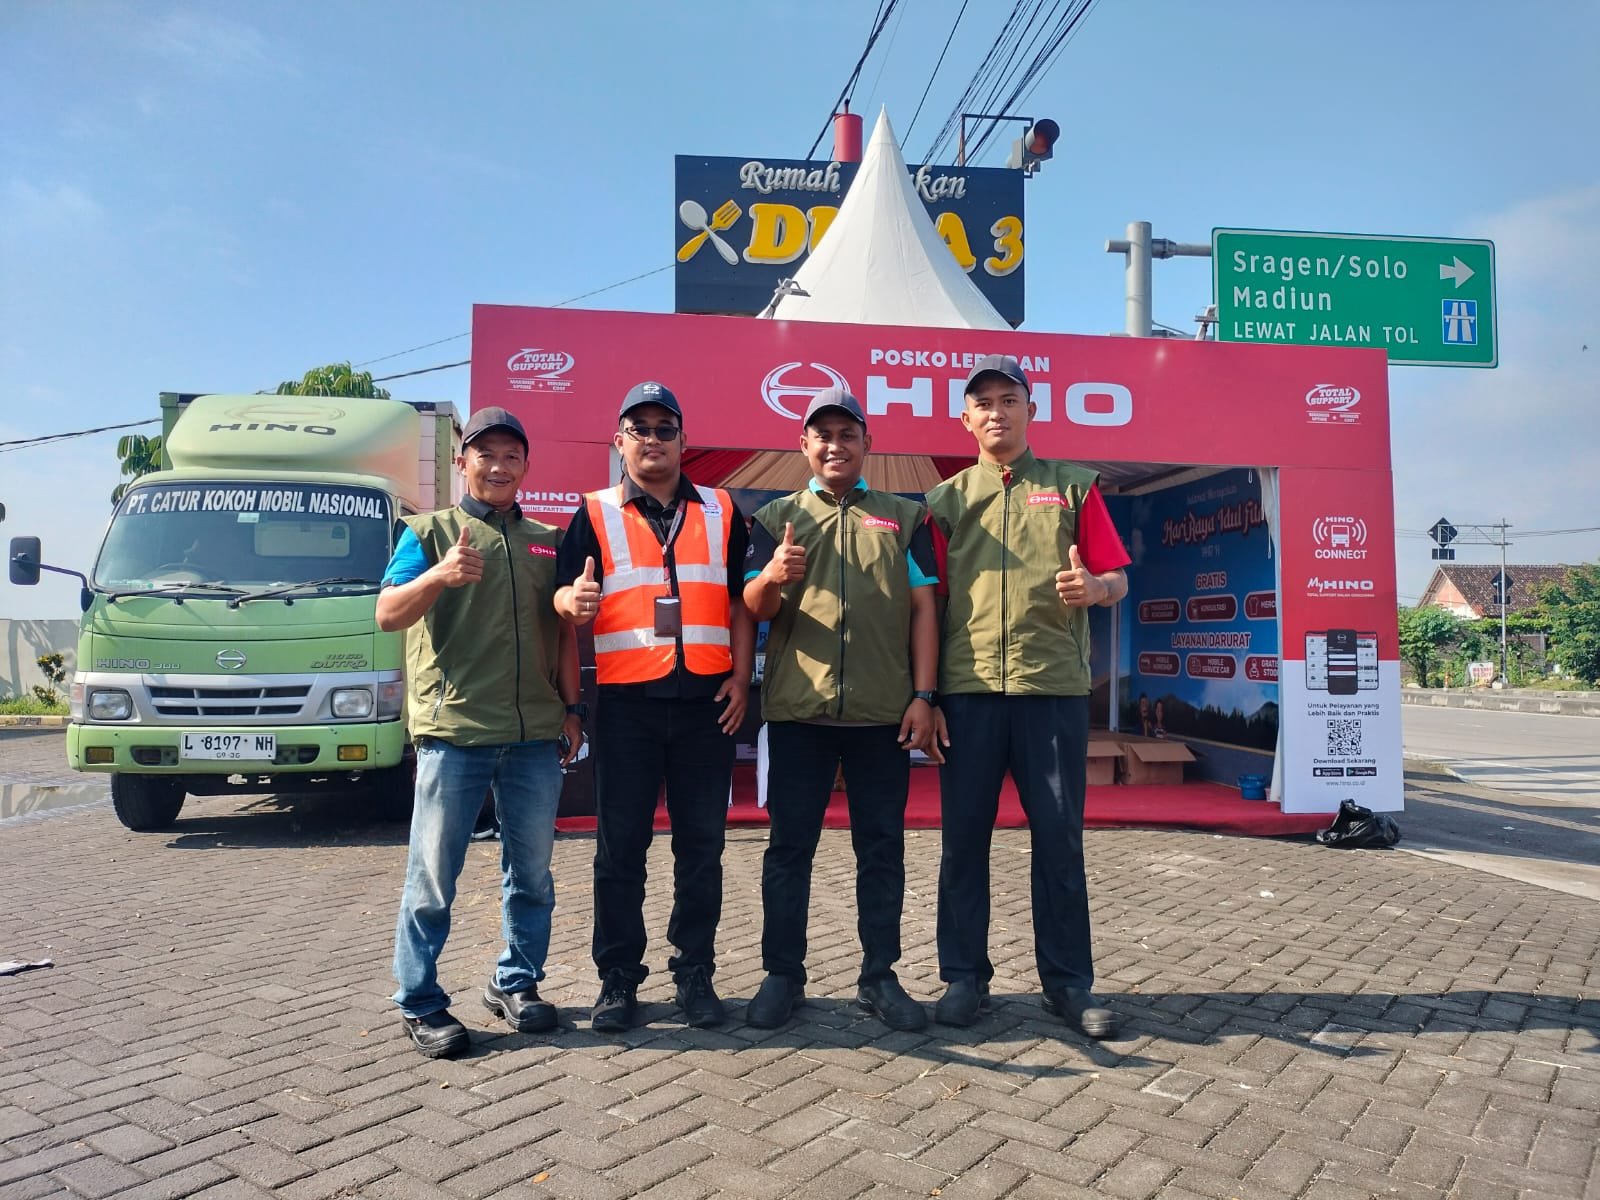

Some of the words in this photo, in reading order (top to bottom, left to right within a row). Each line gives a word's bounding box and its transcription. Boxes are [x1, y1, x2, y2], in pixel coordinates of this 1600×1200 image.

[740, 161, 840, 194] Rumah
[910, 166, 966, 203] kan
[984, 216, 1024, 277] 3
[1233, 250, 1408, 281] Sragen/Solo
[1233, 286, 1332, 311] Madiun
[1234, 321, 1296, 340] LEWAT
[1309, 323, 1371, 342] JALAN
[1382, 326, 1419, 344] TOL
[524, 353, 563, 363] TOTAL
[871, 349, 947, 368] POSKO
[951, 352, 1050, 373] LEAN
[513, 362, 563, 371] SUPPORT
[1319, 388, 1352, 397] TOTAL
[1310, 396, 1352, 405] SUPPORT
[209, 423, 337, 436] HINO
[127, 493, 147, 515] PT.
[150, 490, 200, 512] CATUR
[202, 489, 258, 511] KOKOH
[258, 490, 305, 513] MOBIL
[308, 492, 384, 519] NASIONAL
[525, 491, 580, 503] HINO
[1040, 496, 1065, 505] HIN
[1314, 549, 1368, 560] CONNECT
[1195, 571, 1227, 590] GRATIS
[1171, 632, 1208, 649] LAYANAN
[1208, 632, 1251, 649] DARURAT
[96, 659, 151, 669] HINO
[310, 659, 368, 670] DUTRO
[185, 735, 193, 750] L
[204, 735, 241, 750] 8197
[255, 736, 273, 751] NH
